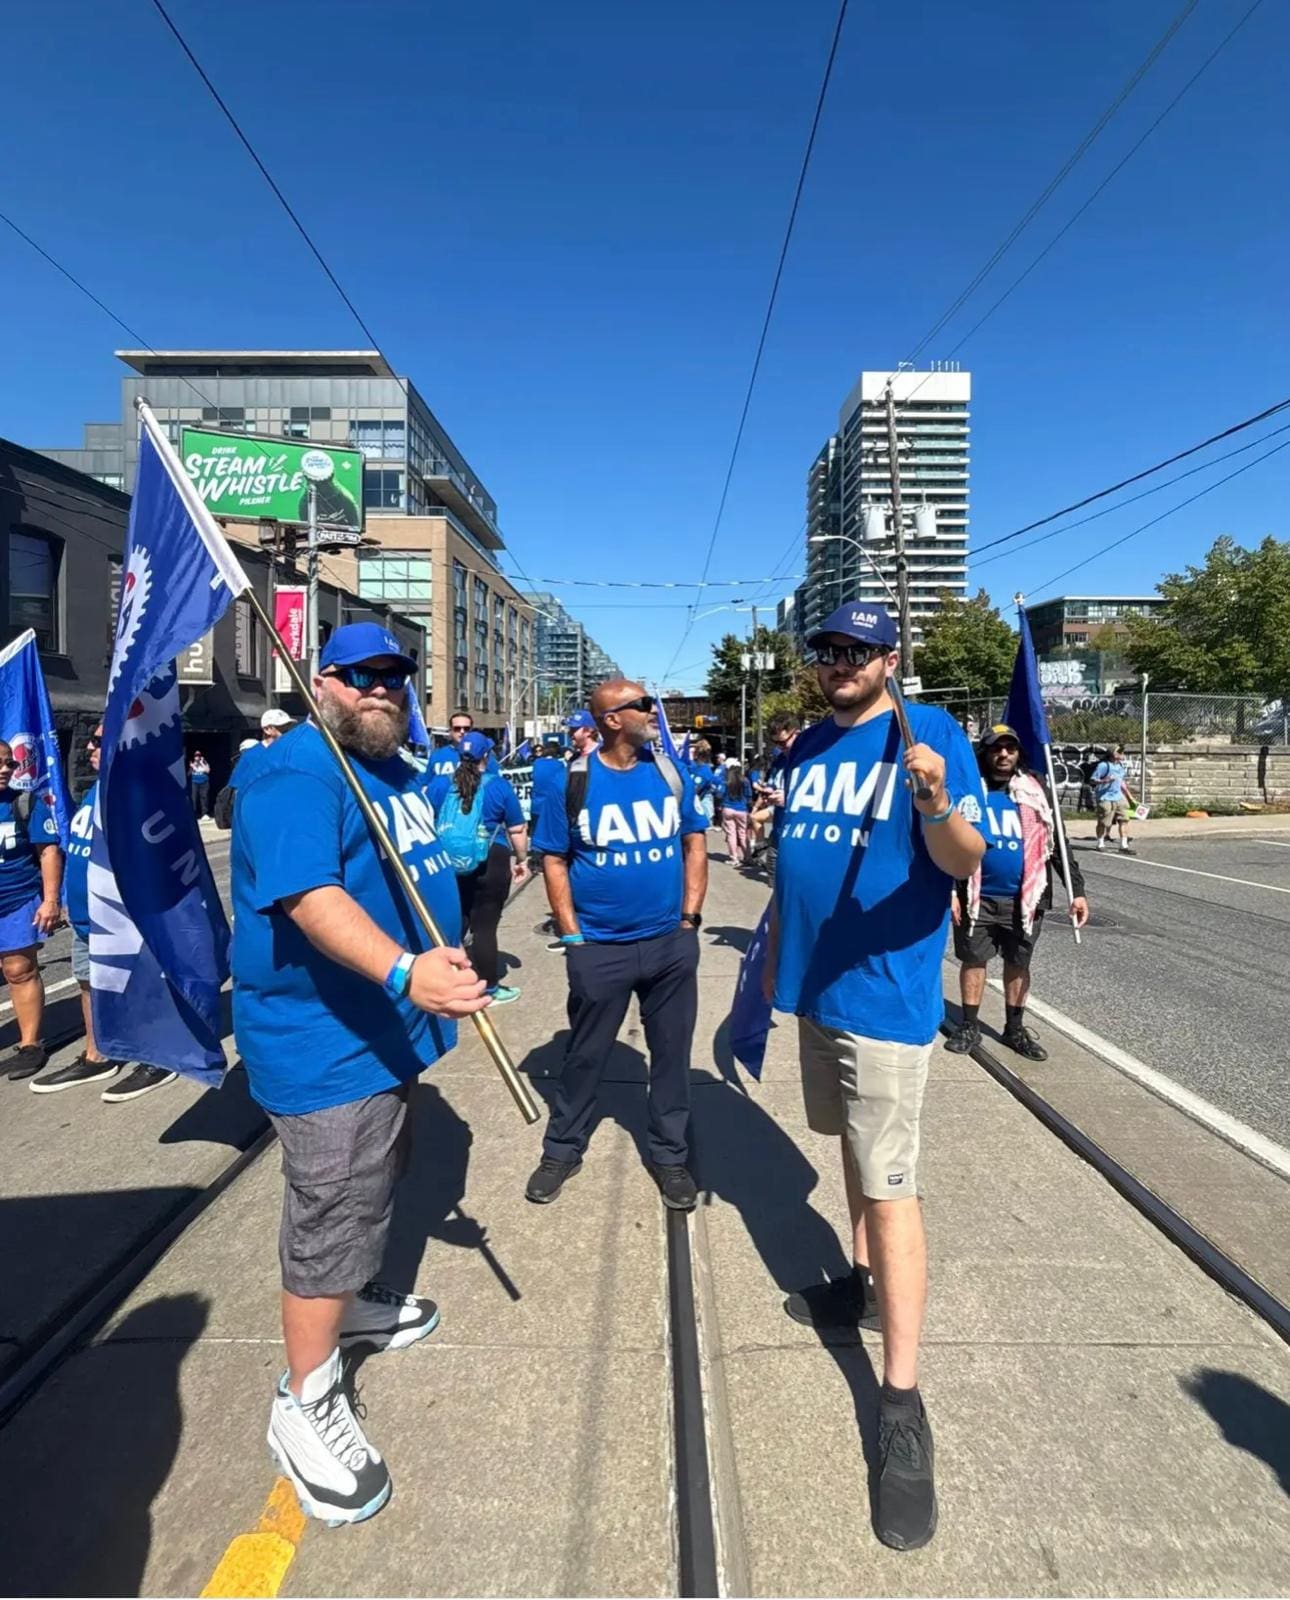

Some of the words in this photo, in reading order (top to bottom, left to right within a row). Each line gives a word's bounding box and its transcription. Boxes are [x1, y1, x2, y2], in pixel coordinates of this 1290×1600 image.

[185, 453, 267, 479] STEAM
[198, 471, 303, 502] WHISTLE
[851, 611, 878, 625] IAM
[183, 637, 204, 673] hu
[786, 762, 898, 821] IAM
[578, 796, 681, 846] IAM
[596, 845, 674, 867] UNION
